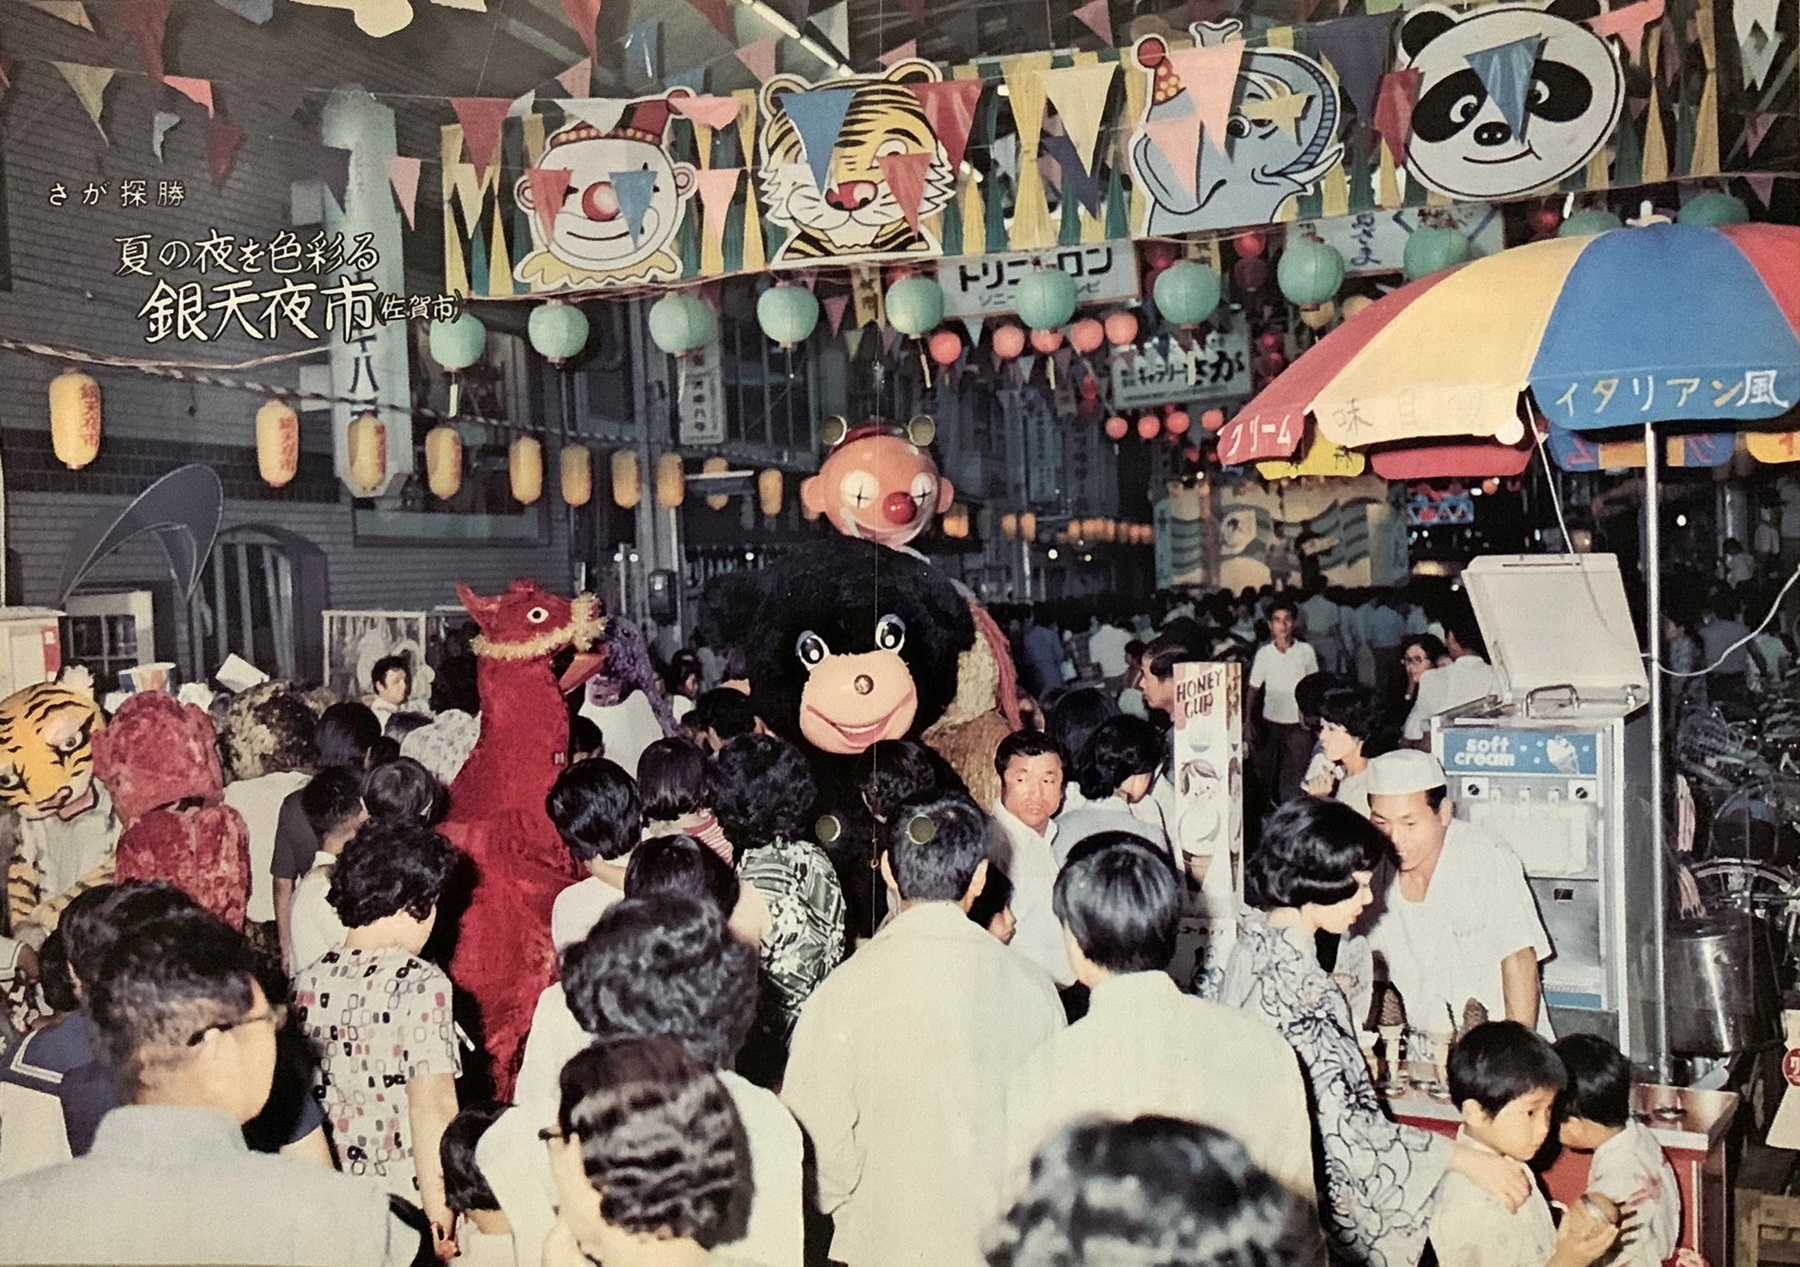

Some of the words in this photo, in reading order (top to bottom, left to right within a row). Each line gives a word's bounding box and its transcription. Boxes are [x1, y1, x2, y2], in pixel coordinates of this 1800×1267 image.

[1555, 369, 1789, 418] イタリアン風
[1226, 413, 1292, 458] クリーム
[1176, 668, 1223, 703] HONEY
[1184, 692, 1214, 719] CUP
[1454, 751, 1516, 767] cream
[1465, 735, 1510, 754] soft
